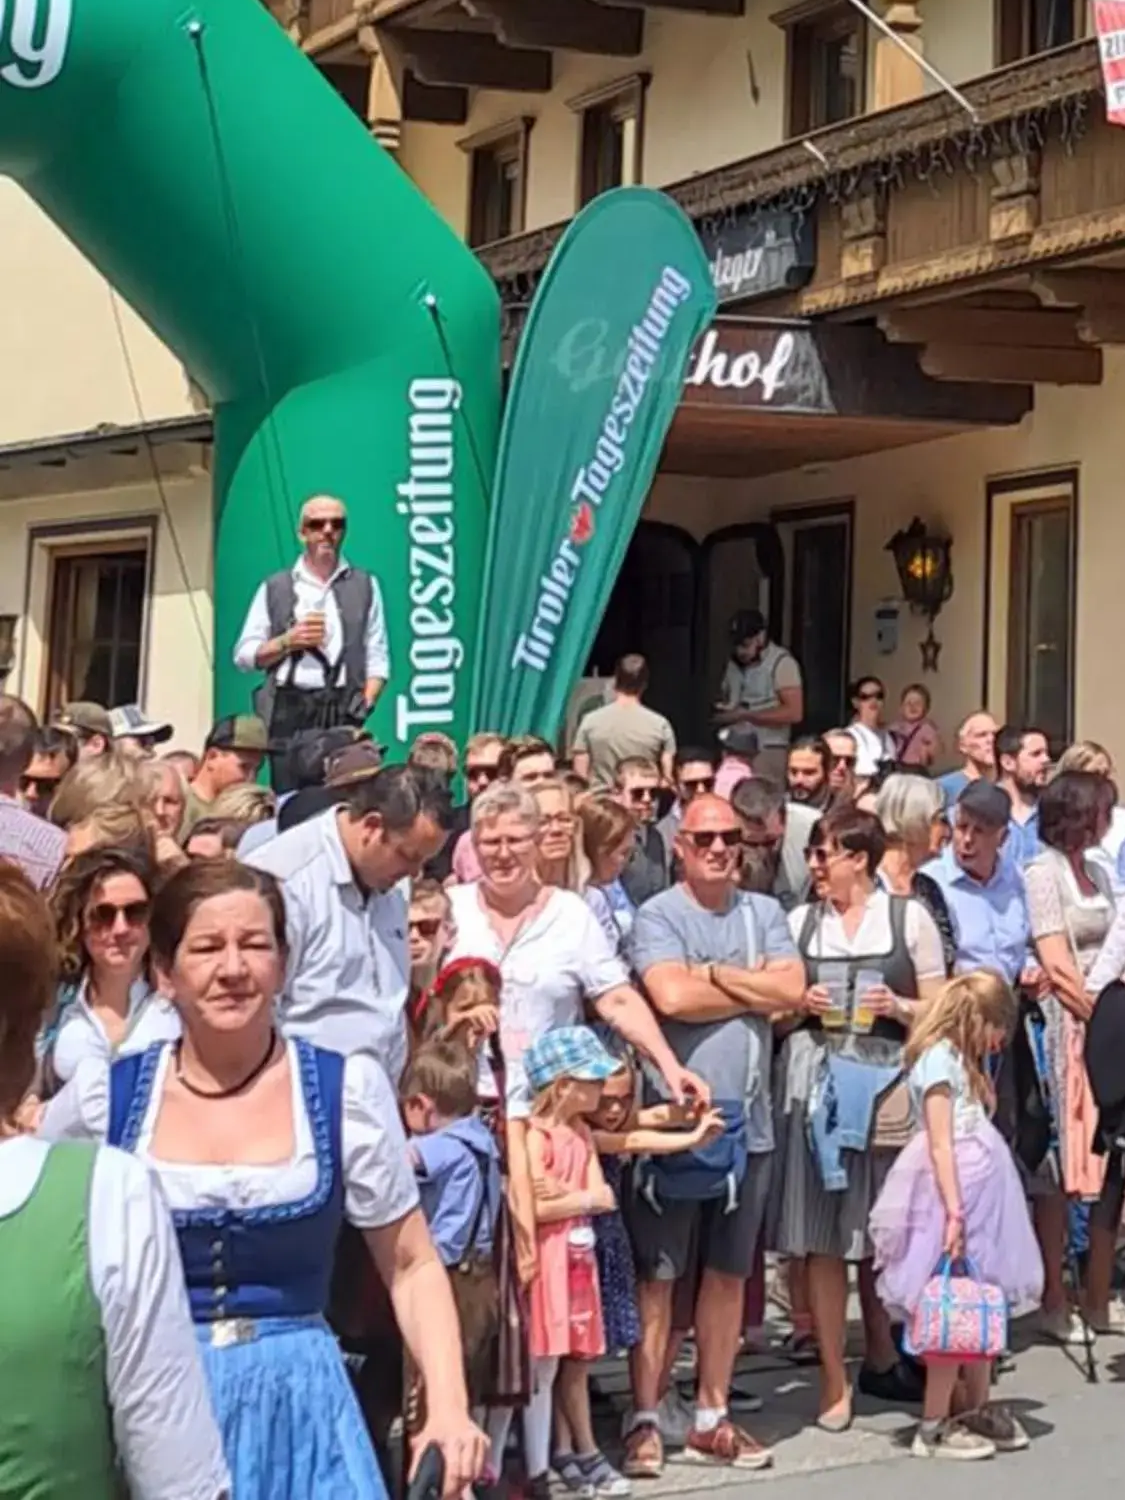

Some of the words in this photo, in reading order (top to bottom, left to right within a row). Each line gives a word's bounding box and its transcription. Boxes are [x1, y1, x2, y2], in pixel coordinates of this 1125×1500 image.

[396, 377, 464, 742] Tageszeitung
[512, 539, 582, 672] Tiroler
[570, 266, 692, 506] Tageszeitung
